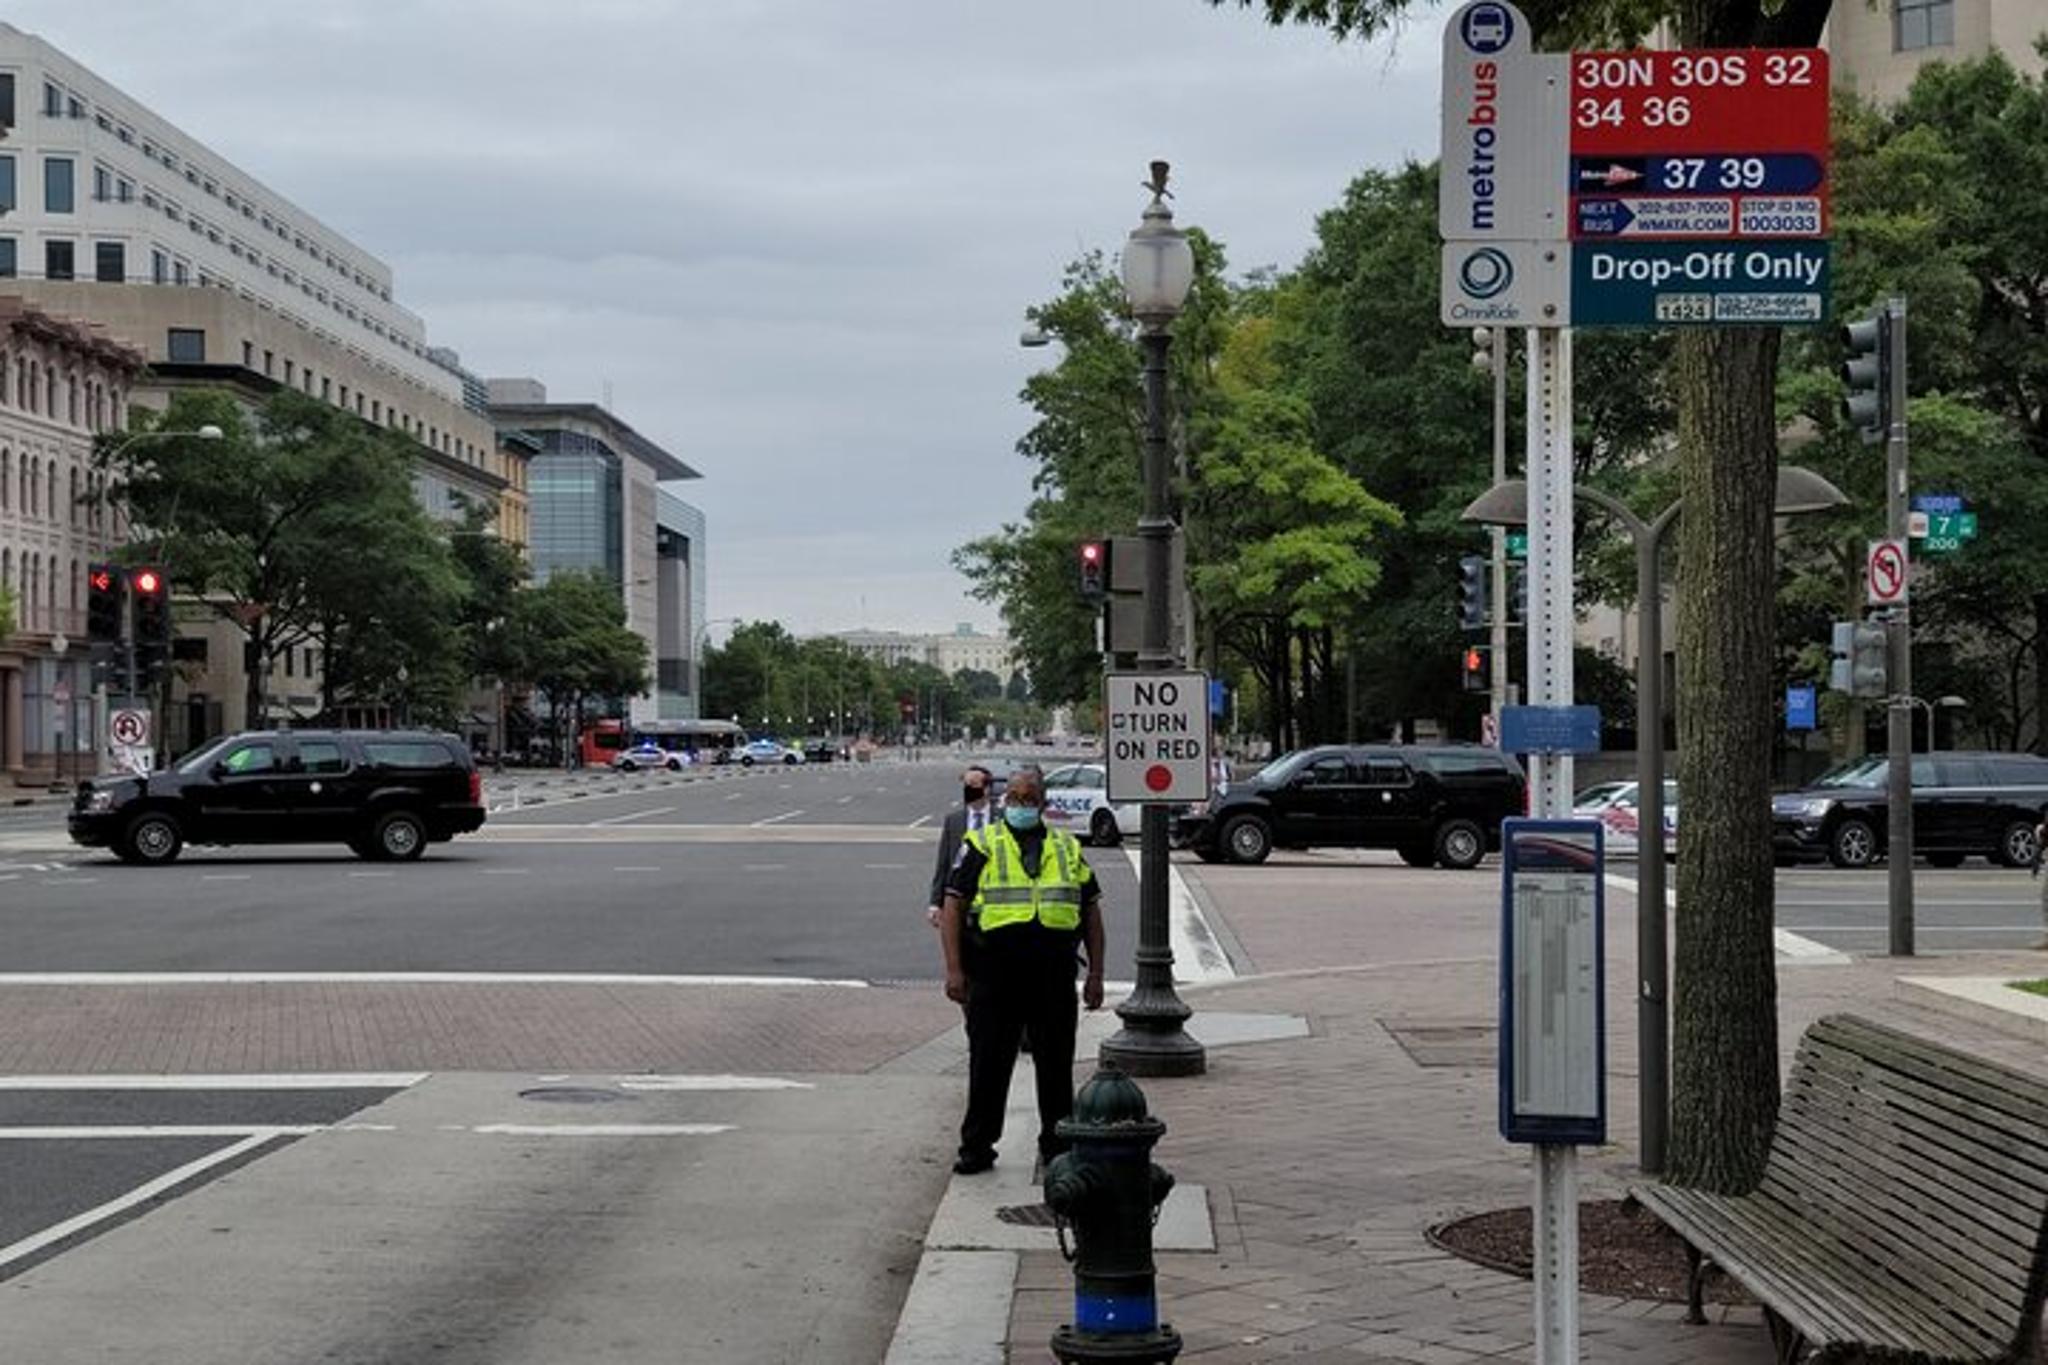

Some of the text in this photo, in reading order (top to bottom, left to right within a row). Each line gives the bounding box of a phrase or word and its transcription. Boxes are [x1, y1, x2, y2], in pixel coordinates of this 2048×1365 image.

[1577, 55, 1812, 88] 30N 30S 32
[1577, 96, 1691, 127] 34 36
[1467, 61, 1497, 229] metrobus
[1663, 158, 1765, 188] 37 39
[1579, 202, 1617, 214] NEXT
[1741, 201, 1775, 213] STOP
[1778, 201, 1793, 213] ID
[1583, 218, 1614, 231] BUS
[1637, 218, 1730, 232] WMATA.COM
[1742, 215, 1816, 231] 1003033
[1592, 252, 1823, 286] Drop-Off Only
[1450, 303, 1519, 319] OmniRide
[1661, 304, 1706, 320] 1424
[1937, 516, 1951, 535] 7
[1928, 537, 1958, 550] 200
[1134, 682, 1179, 706] NO
[1129, 713, 1187, 733] TURN
[1115, 739, 1200, 760] ON RED
